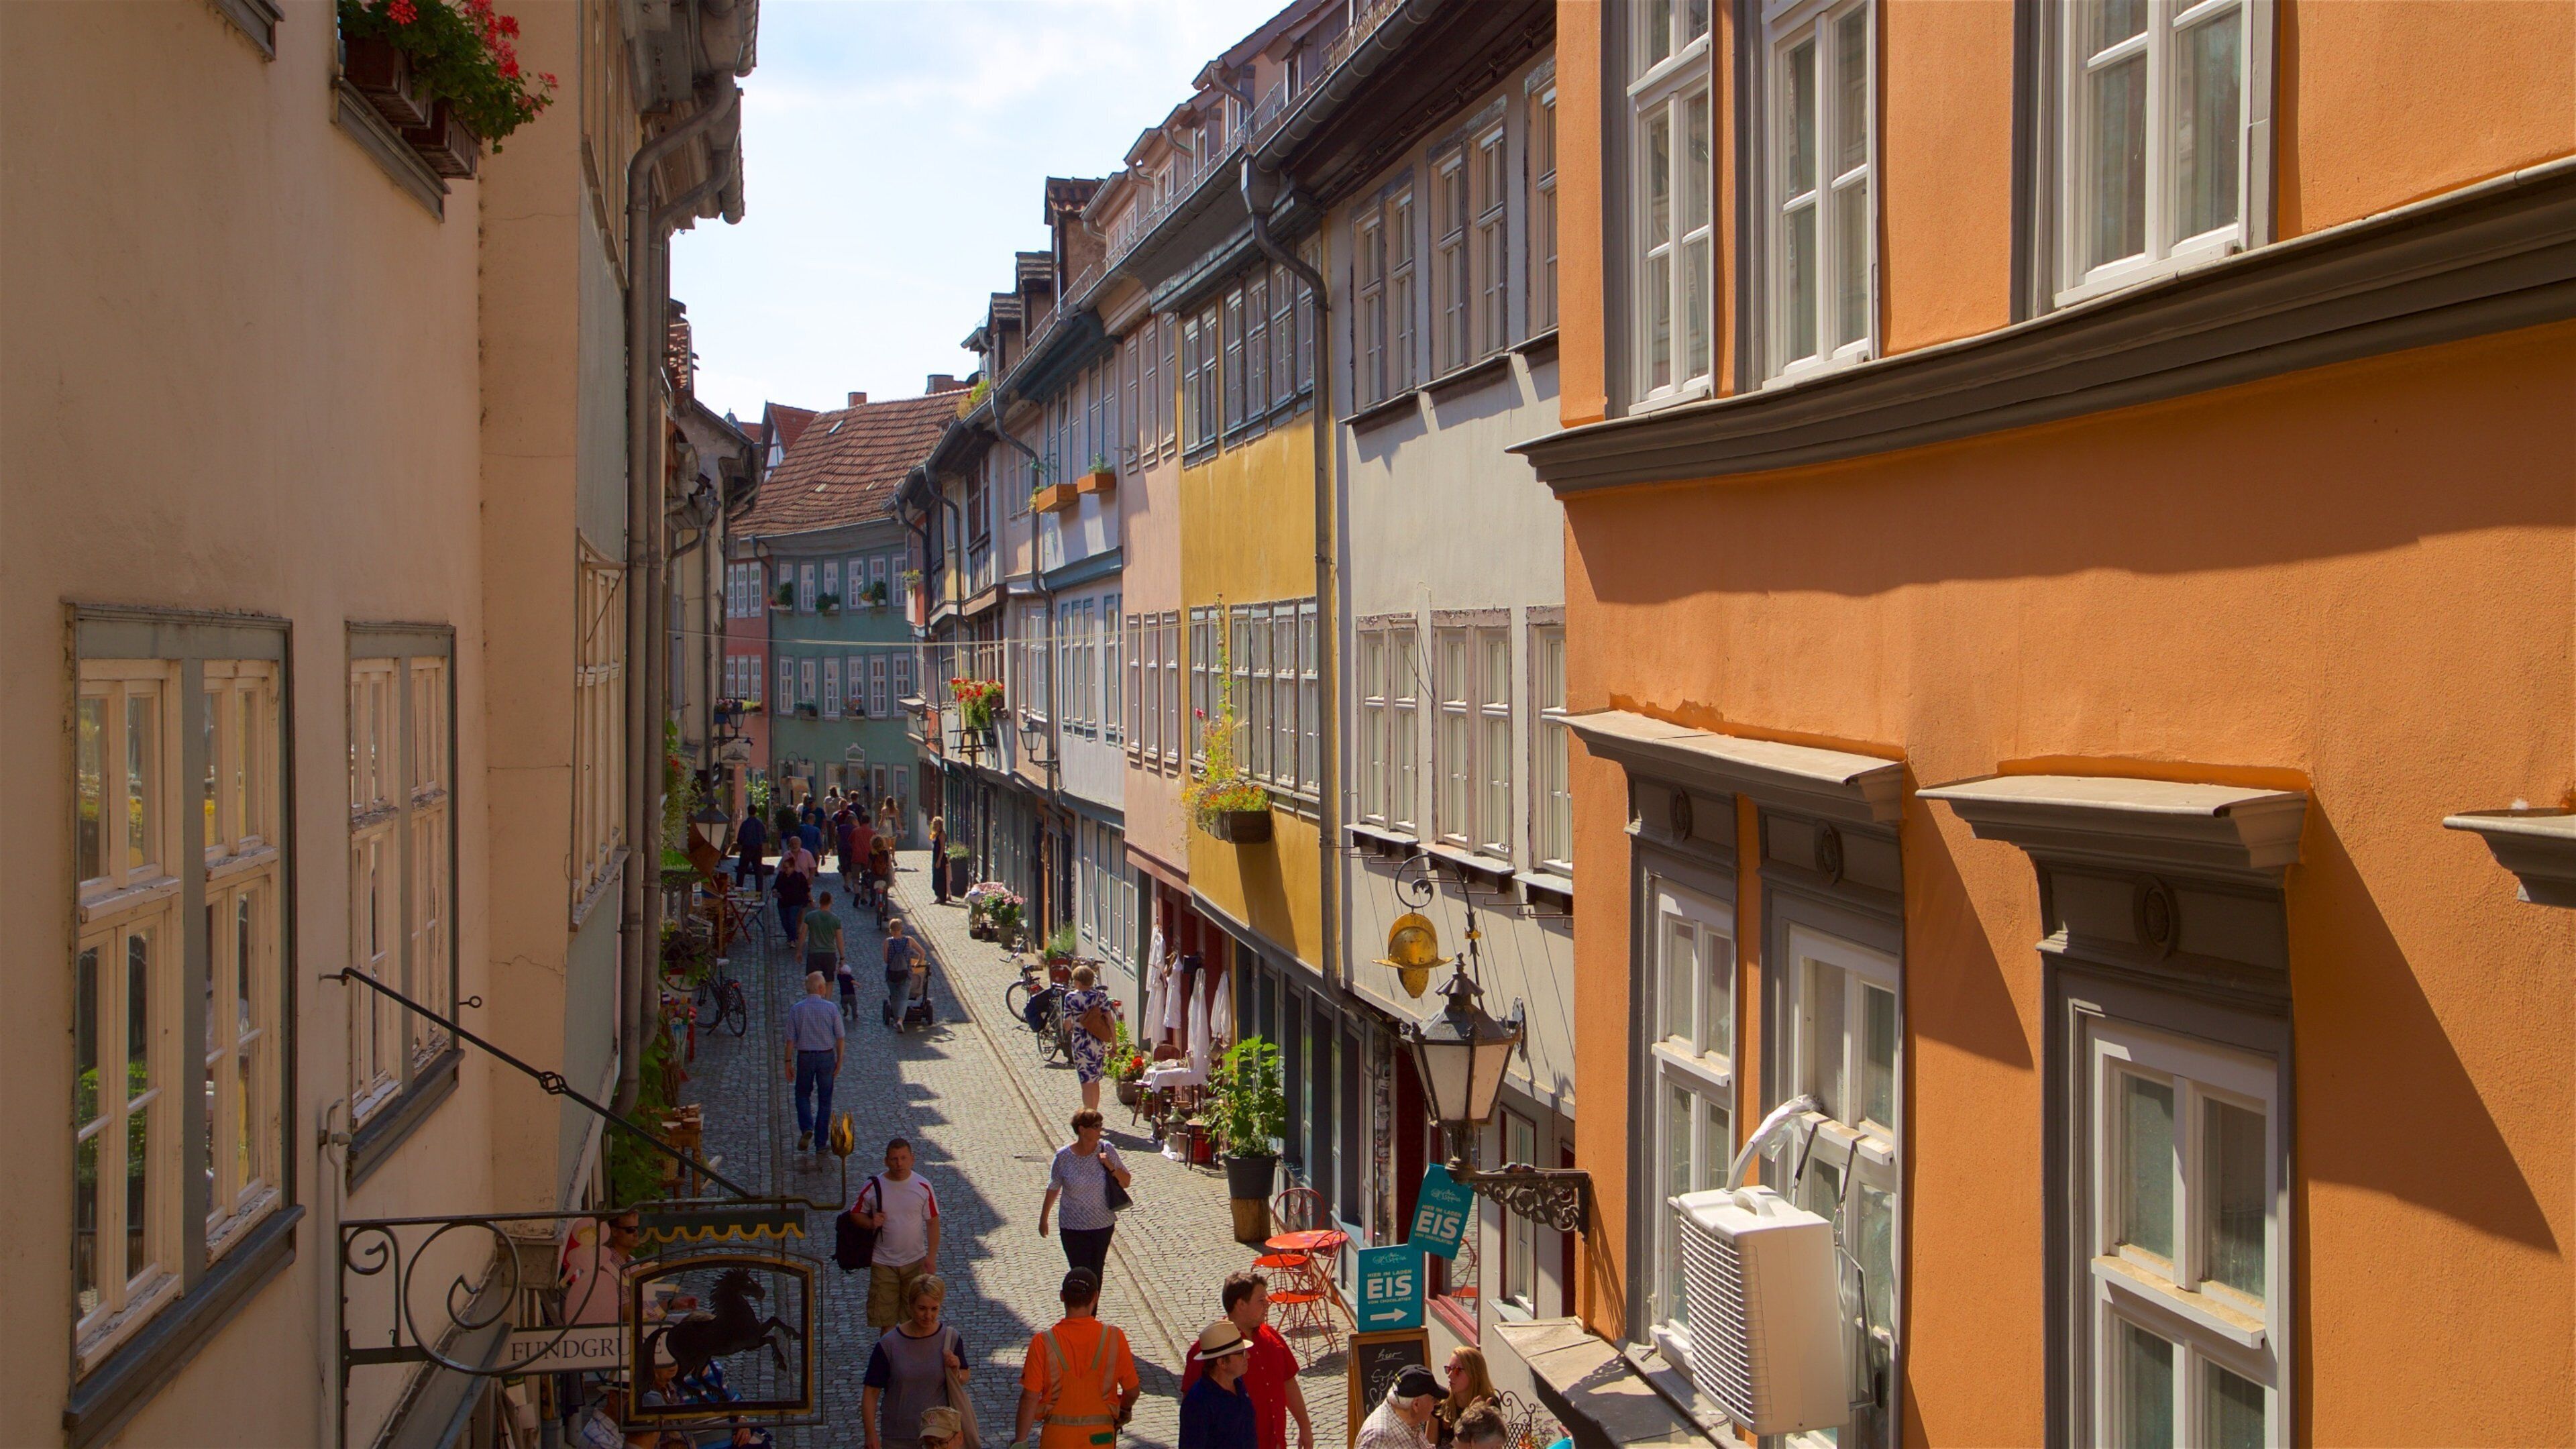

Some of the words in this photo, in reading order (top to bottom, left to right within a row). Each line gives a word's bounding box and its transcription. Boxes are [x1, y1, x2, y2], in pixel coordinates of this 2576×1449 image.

[1415, 1210, 1460, 1239] EIS
[1444, 1210, 1462, 1218] LADEN
[1367, 1275, 1412, 1299] EIS
[511, 1337, 663, 1361] FUNDGRUE
